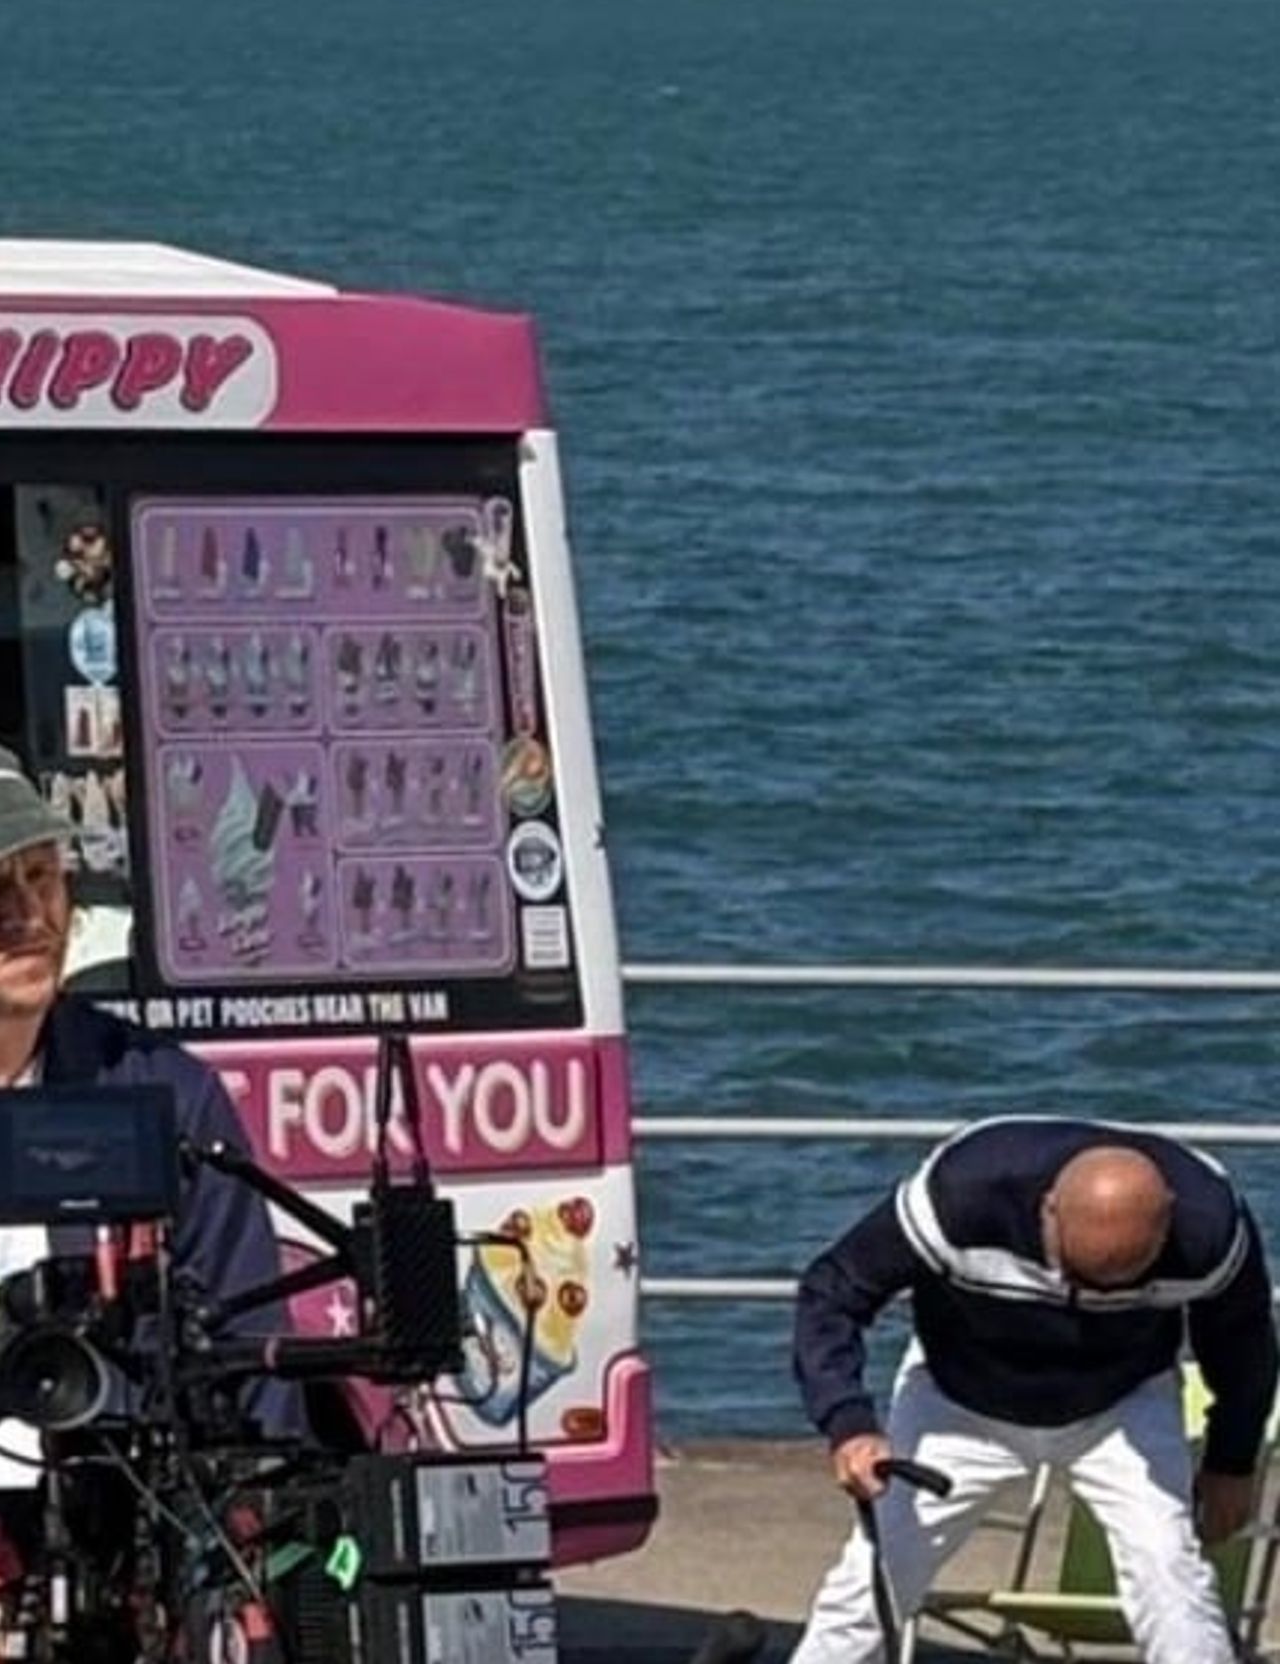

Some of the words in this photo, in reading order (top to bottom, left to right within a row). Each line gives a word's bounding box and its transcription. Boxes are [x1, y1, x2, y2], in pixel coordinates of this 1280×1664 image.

[177, 997, 214, 1028] PET
[220, 995, 309, 1028] POOCHES
[312, 994, 364, 1024] NEAR
[367, 992, 405, 1022] THE
[407, 991, 449, 1020] VAN
[266, 1066, 416, 1161] FOR
[426, 1057, 586, 1154] YOU
